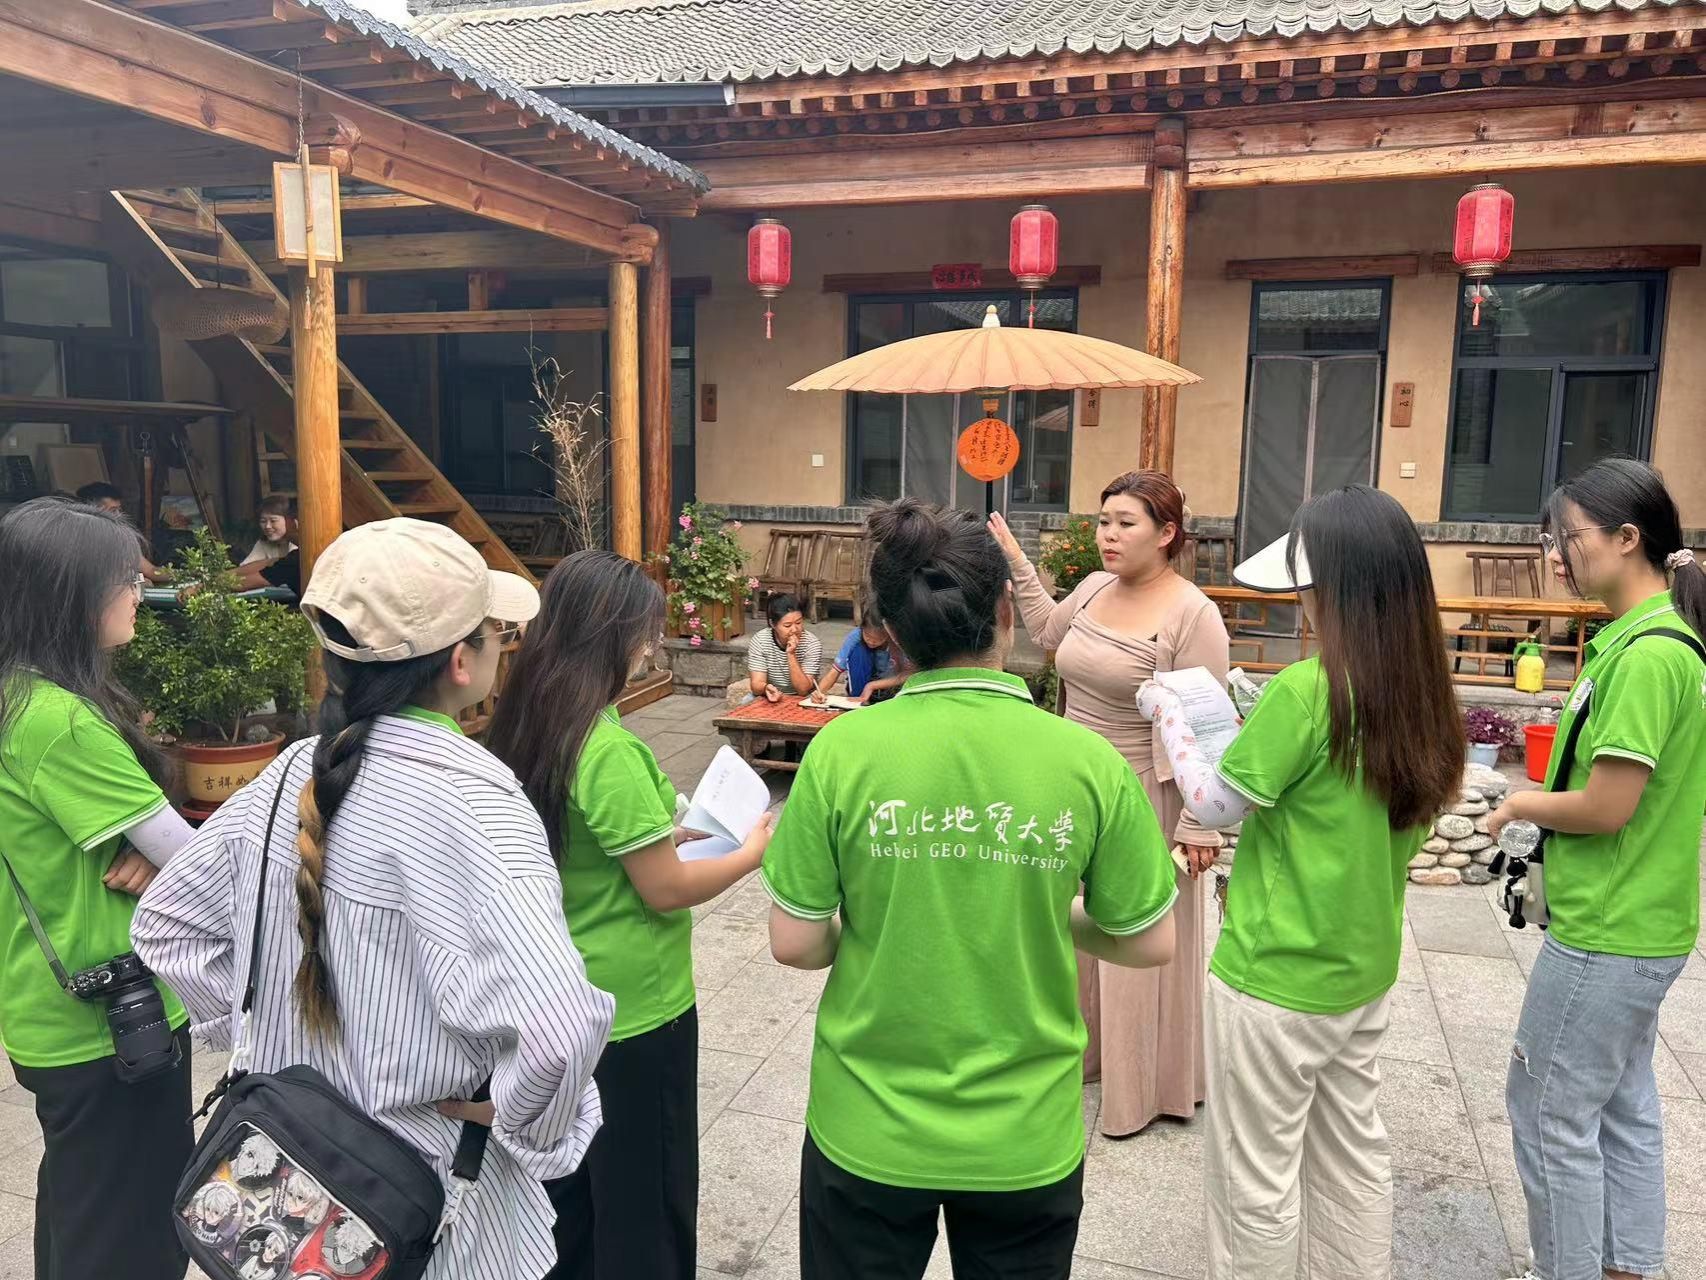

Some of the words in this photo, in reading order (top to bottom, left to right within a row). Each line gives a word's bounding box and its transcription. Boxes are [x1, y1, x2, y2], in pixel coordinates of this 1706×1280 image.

[203, 770, 260, 791] 吉祥如
[870, 842, 918, 859] Hebei
[929, 842, 967, 858] GEO
[978, 844, 1069, 872] University
